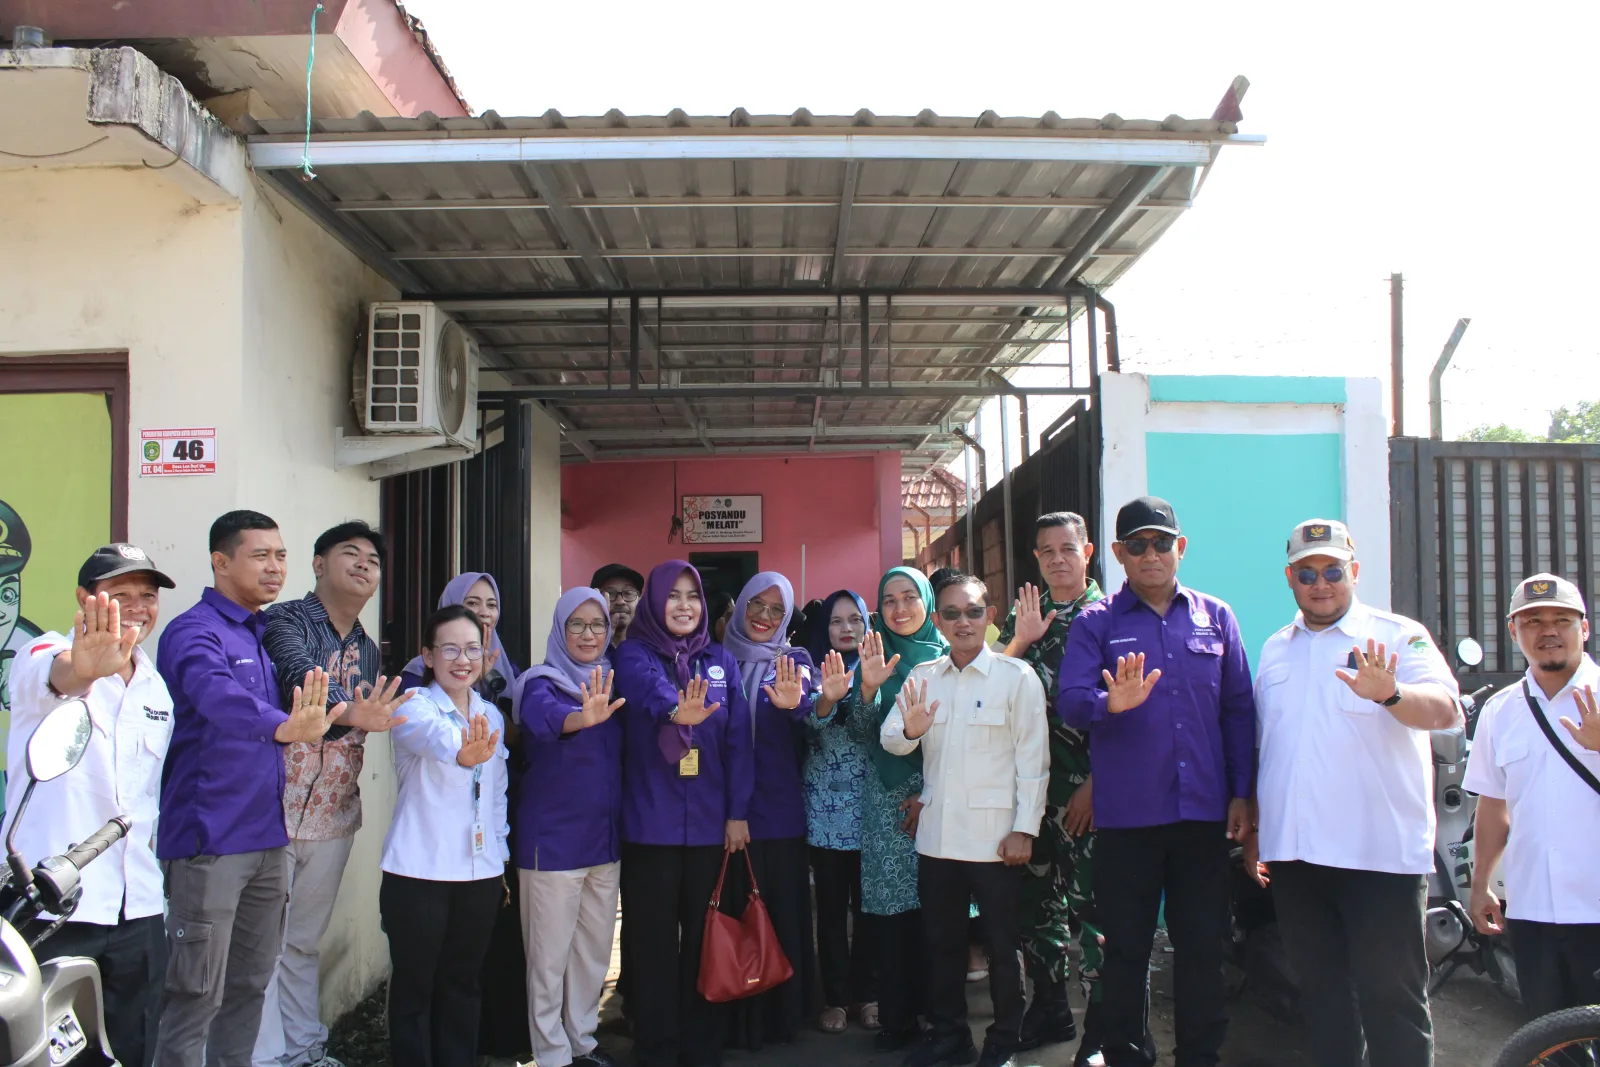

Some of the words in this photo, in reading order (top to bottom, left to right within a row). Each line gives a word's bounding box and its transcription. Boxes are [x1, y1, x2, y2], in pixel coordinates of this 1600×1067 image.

[173, 439, 204, 460] 46
[142, 465, 153, 474] RT.
[153, 465, 163, 473] 04
[698, 510, 746, 520] POSYANDU
[701, 520, 743, 529] "MELATI"
